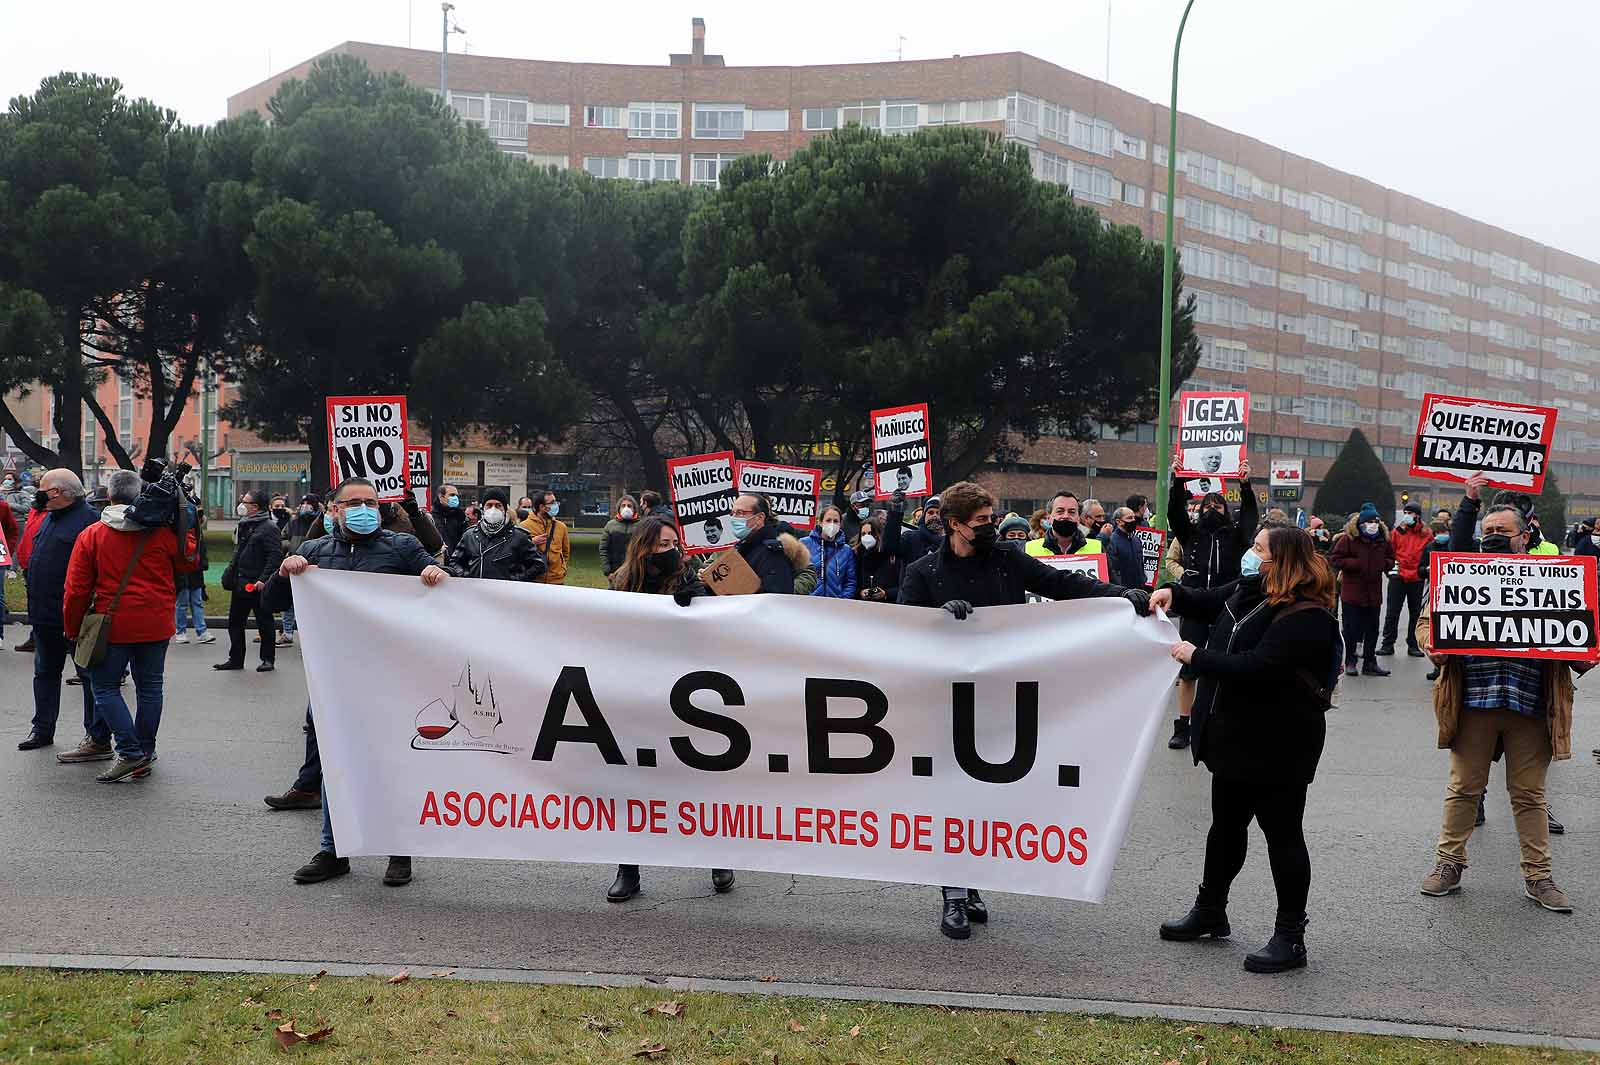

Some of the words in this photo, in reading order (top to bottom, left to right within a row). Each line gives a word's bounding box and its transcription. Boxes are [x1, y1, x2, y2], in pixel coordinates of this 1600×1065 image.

[342, 405, 359, 422] SI
[366, 405, 393, 422] NO
[1188, 399, 1239, 422] IGEA
[874, 418, 925, 439] MAÑUECO
[1182, 427, 1244, 442] DIMISIÓN
[1431, 410, 1541, 440] QUEREMOS
[336, 439, 394, 481] NO
[876, 444, 927, 465] DIMISIÓN
[1422, 437, 1544, 474] TRABAJAR
[672, 466, 734, 490] MAÑUECO
[742, 472, 813, 493] QUEREMOS
[770, 495, 815, 516] BAJAR
[1447, 563, 1466, 575] NO
[1469, 564, 1515, 577] SOMOS
[1519, 566, 1536, 577] EL
[1539, 566, 1579, 579] VIRUS
[1500, 577, 1524, 586] PERO
[1444, 585, 1491, 606] NOS
[1500, 587, 1582, 609] ESTAIS
[1439, 614, 1589, 646] MATANDO
[531, 665, 1080, 787] A.S.B.U.
[419, 791, 616, 832] ASOCIACION
[626, 799, 668, 834] DE
[677, 800, 879, 848] SUMILLERES
[890, 812, 934, 852] DE
[943, 817, 1089, 866] BURGOS
